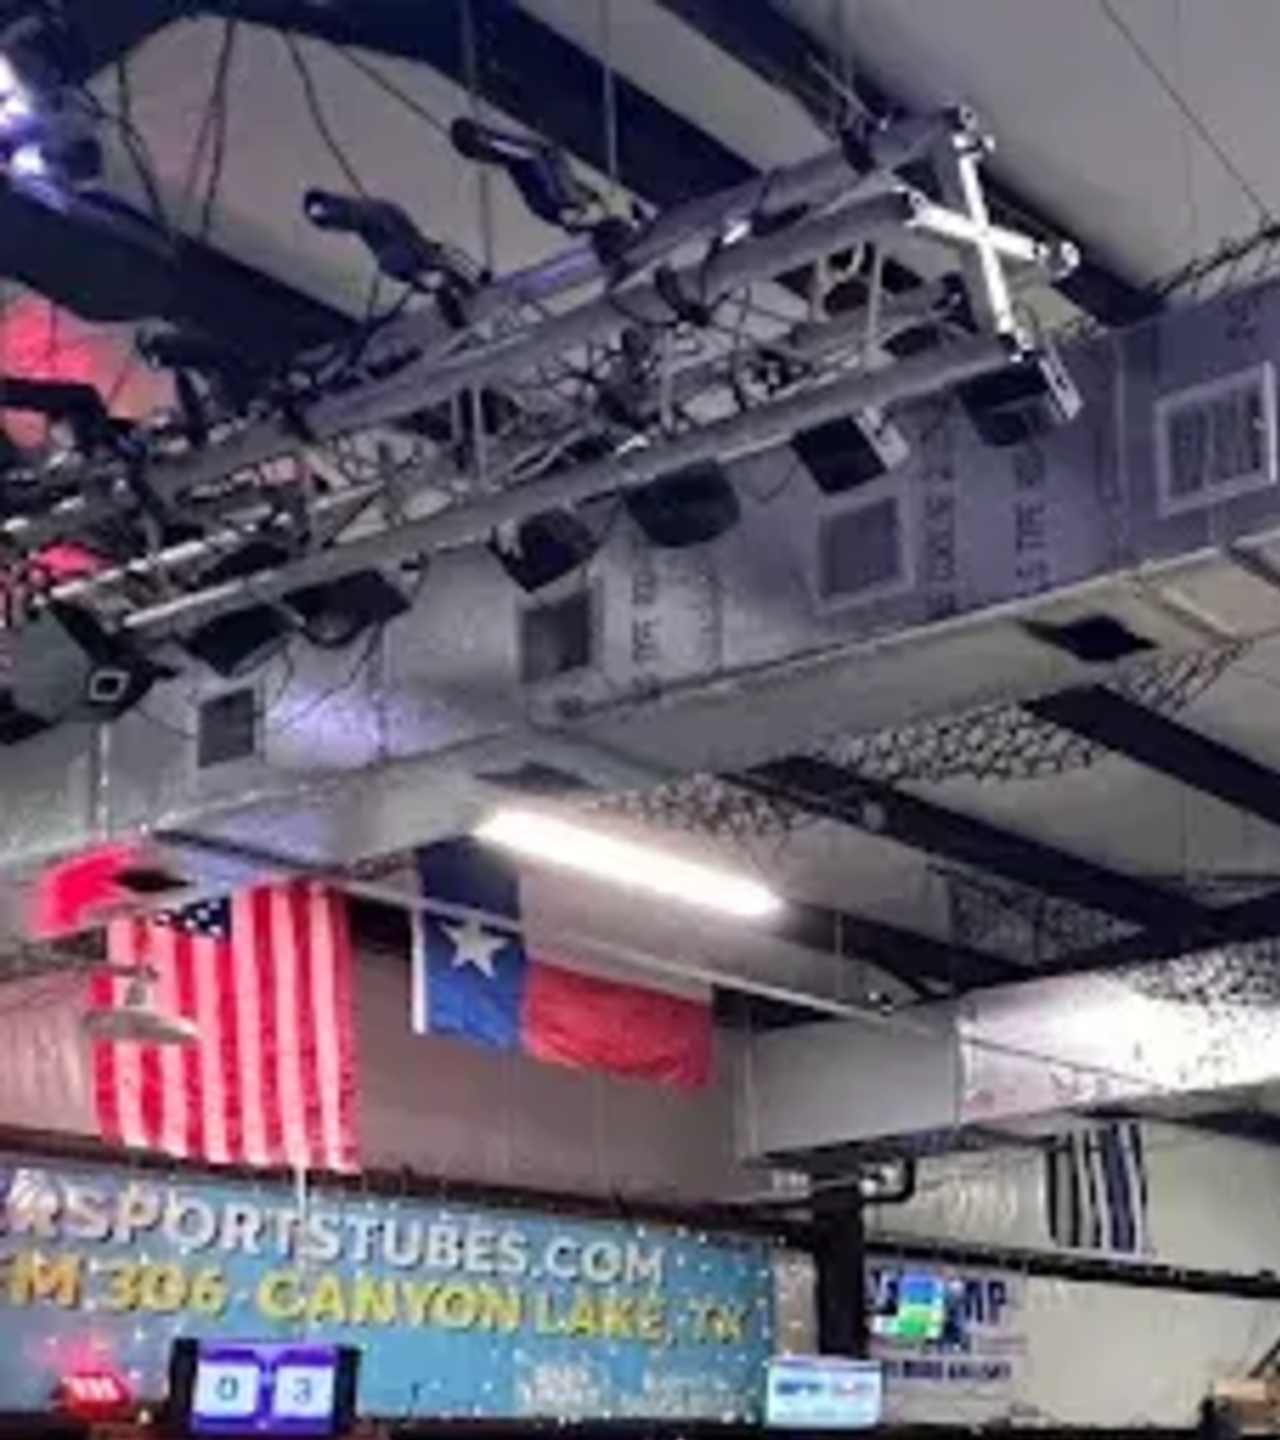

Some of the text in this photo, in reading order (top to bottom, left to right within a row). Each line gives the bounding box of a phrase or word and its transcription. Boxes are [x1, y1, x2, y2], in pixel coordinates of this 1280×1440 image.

[0, 1170, 665, 1284] RSPORTSTUBES.COM
[104, 1260, 227, 1318] 306
[257, 1266, 522, 1334] CANYON
[216, 1377, 238, 1400] 0
[293, 1378, 312, 1400] 3
